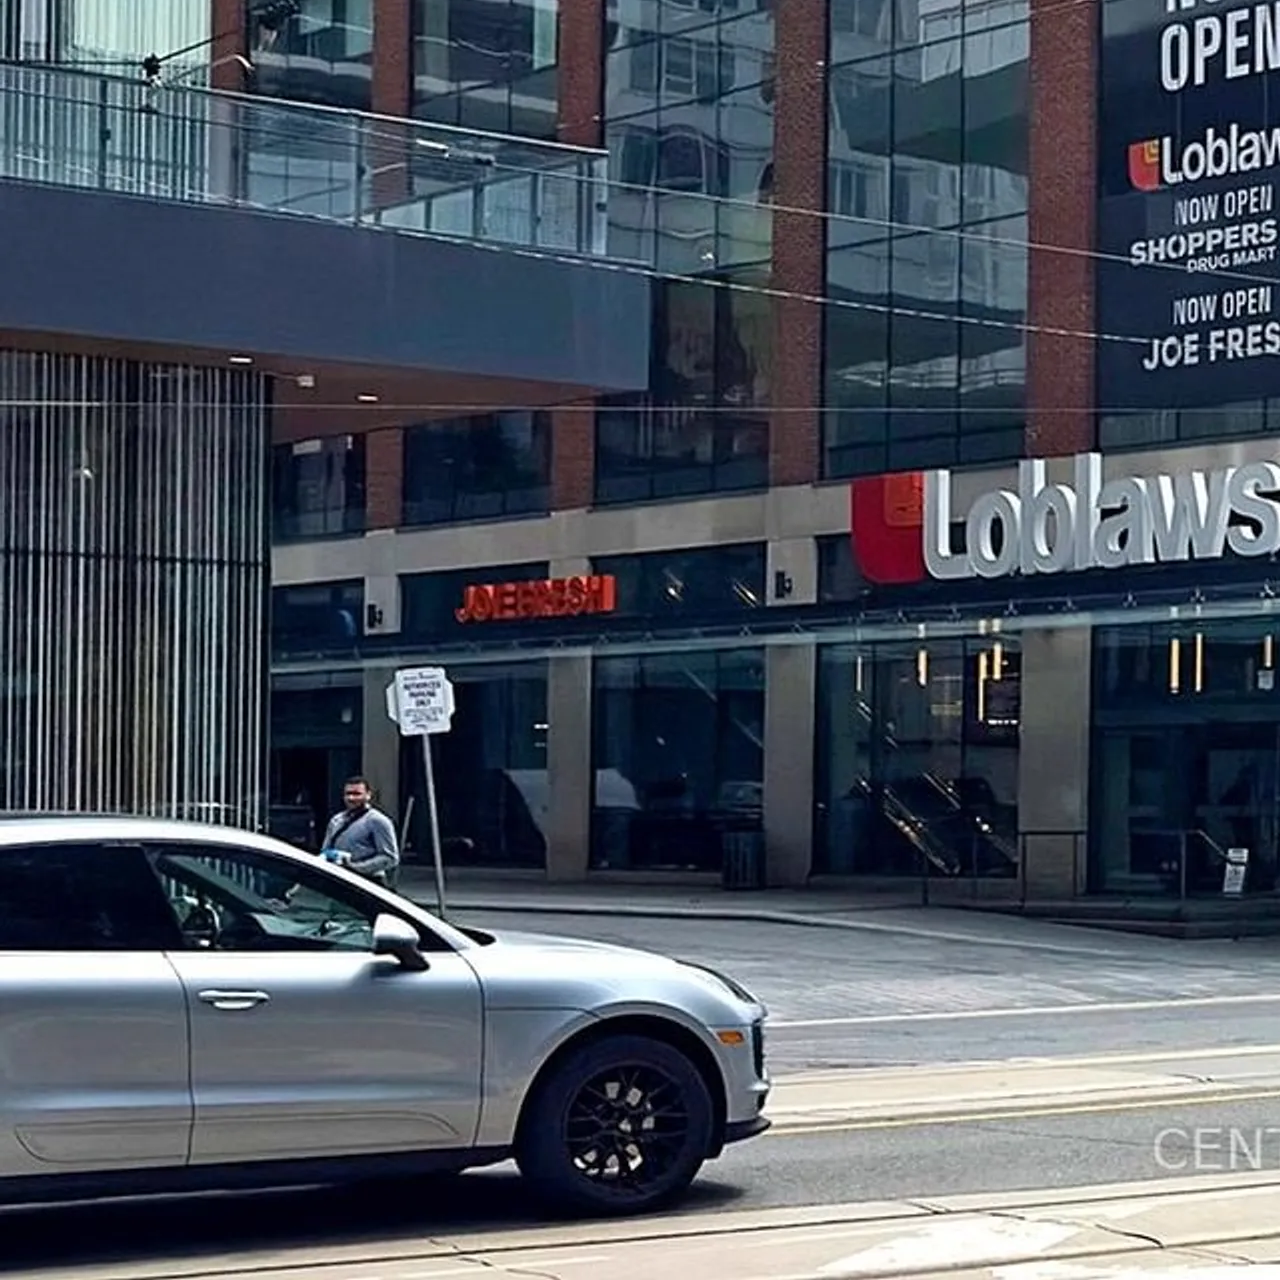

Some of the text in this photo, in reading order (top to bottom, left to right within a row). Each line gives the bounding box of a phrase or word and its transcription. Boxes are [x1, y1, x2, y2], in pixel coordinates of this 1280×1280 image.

[1174, 184, 1273, 226] NOW OPEN
[1130, 219, 1278, 266] SHOPPERS
[1187, 245, 1277, 273] DRUG MART
[1173, 286, 1272, 326] NOW OPEN
[1143, 333, 1200, 371] JOE
